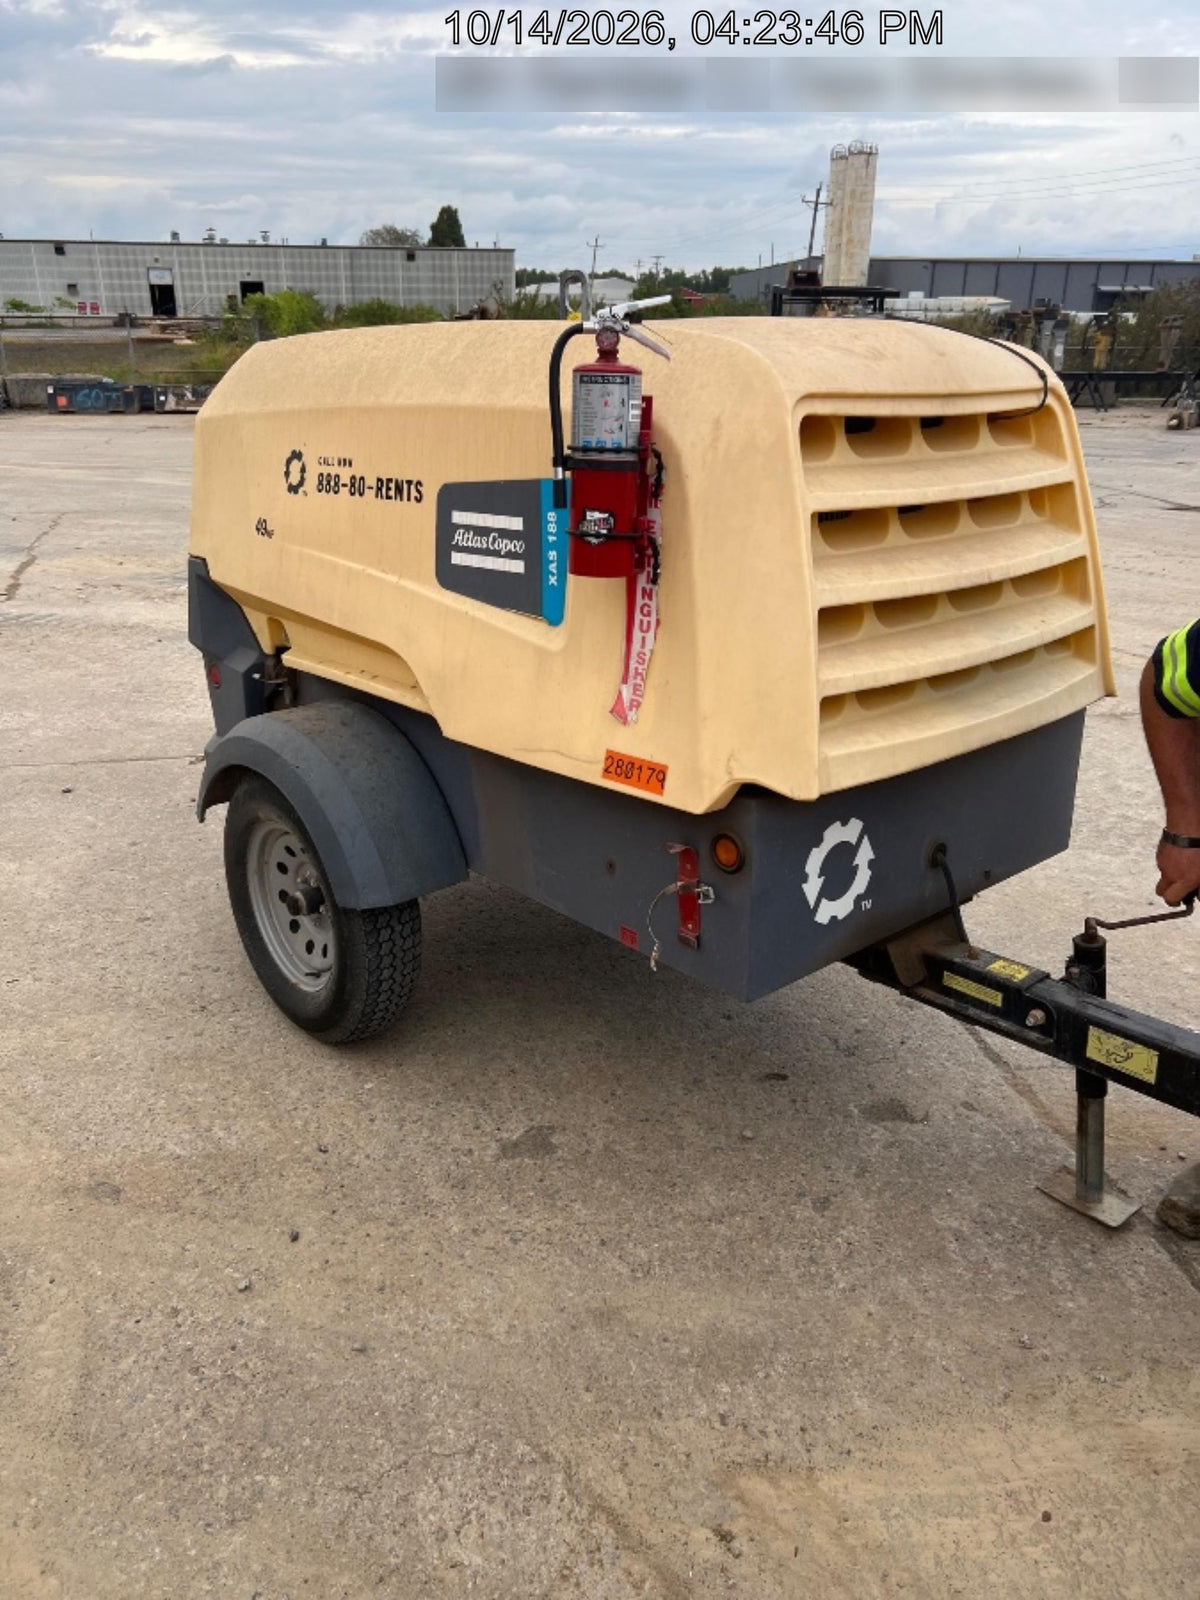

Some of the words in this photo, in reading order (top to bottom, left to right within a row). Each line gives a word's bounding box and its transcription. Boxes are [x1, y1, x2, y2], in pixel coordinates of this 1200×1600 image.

[317, 473, 424, 503] 888-80-RENTS
[546, 511, 558, 543] 188
[546, 549, 558, 587] XAS
[603, 755, 666, 790] 280179
